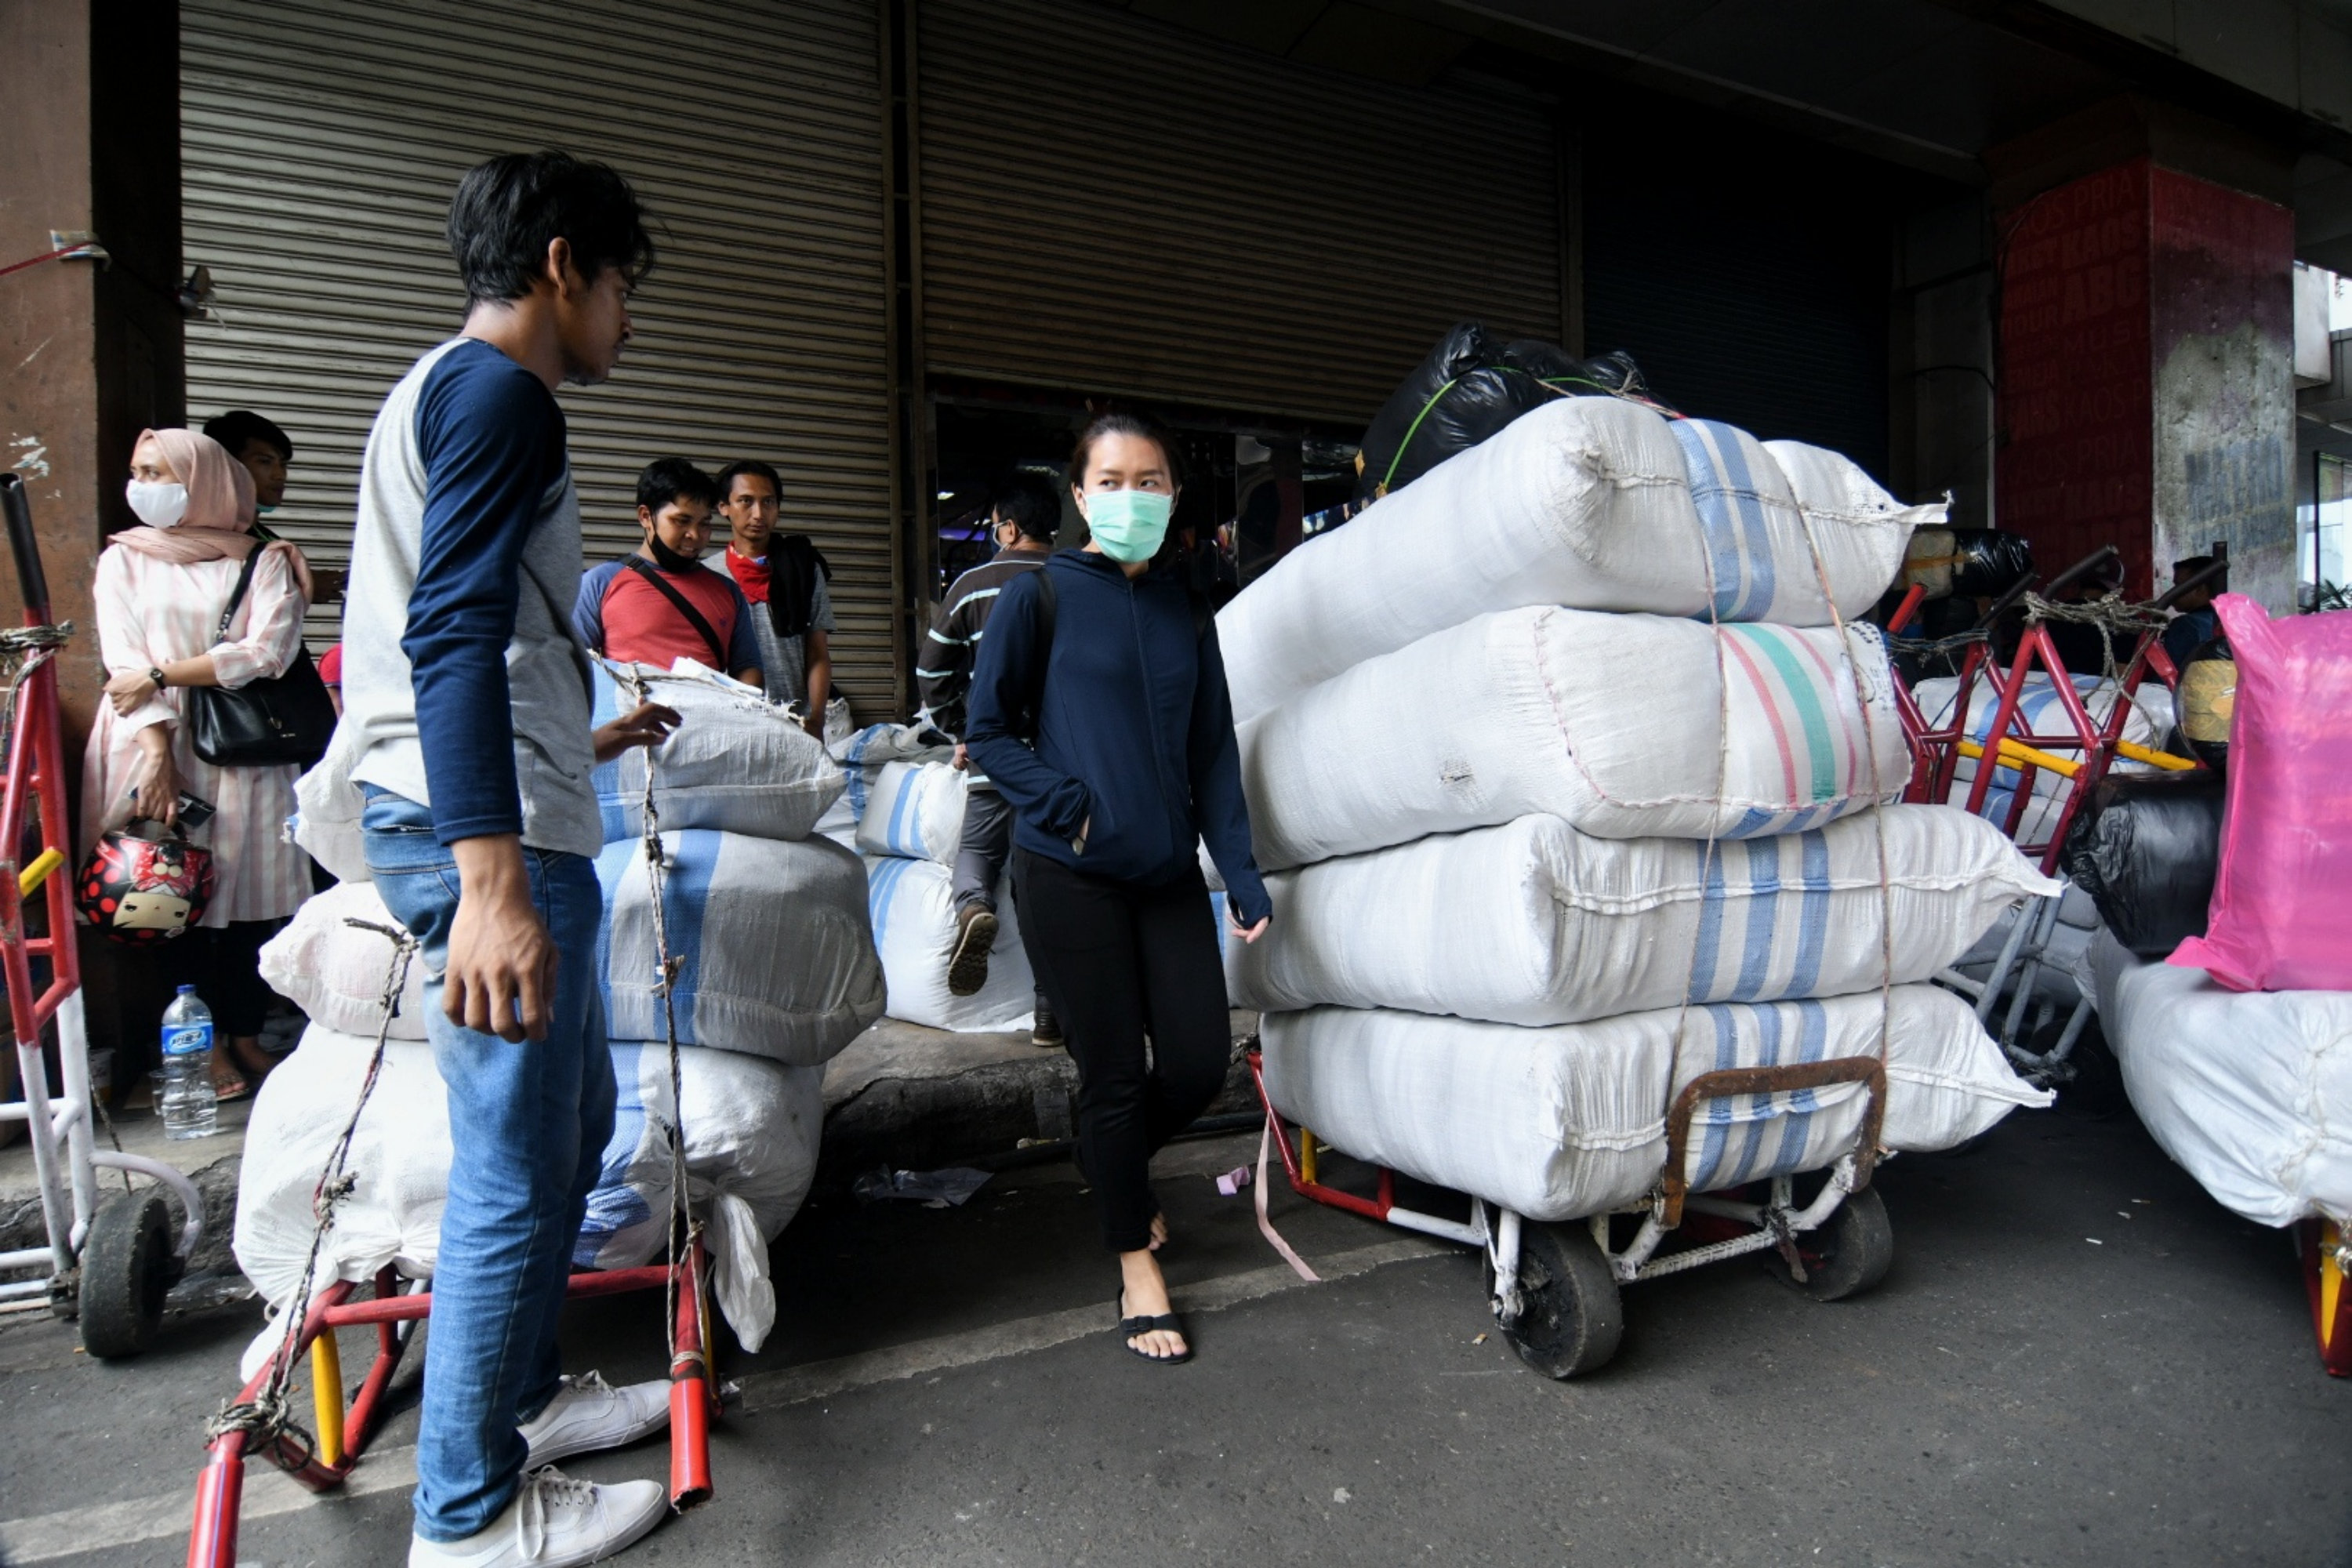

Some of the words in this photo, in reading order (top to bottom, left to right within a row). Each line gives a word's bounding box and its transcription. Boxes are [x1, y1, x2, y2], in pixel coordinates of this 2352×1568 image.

[2074, 170, 2136, 222] PRIA
[2061, 209, 2141, 270] KAOS
[2062, 255, 2142, 327] ABG
[2076, 429, 2139, 475] PRIA
